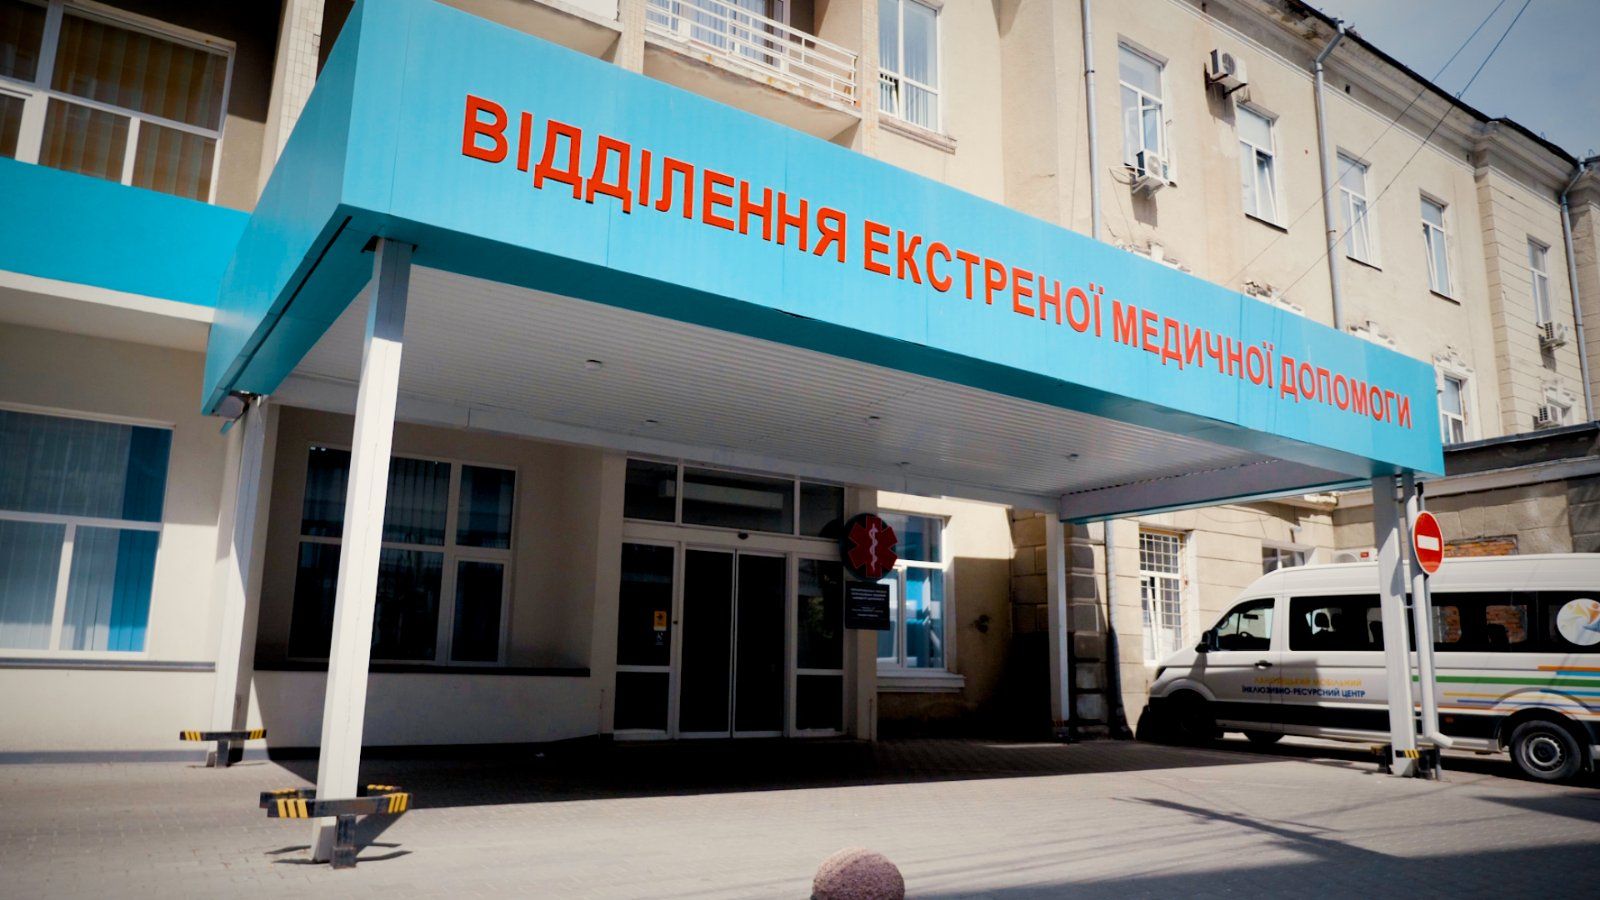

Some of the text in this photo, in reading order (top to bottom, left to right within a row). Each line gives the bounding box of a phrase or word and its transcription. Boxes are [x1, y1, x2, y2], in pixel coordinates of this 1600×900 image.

[461, 94, 1411, 429] ВІДДІЛЕННЯ ЕКСТРЕНОЇ МЕДИЧНОЇ ДОПОМОГИ
[1342, 689, 1366, 698] ЦЕНТР
